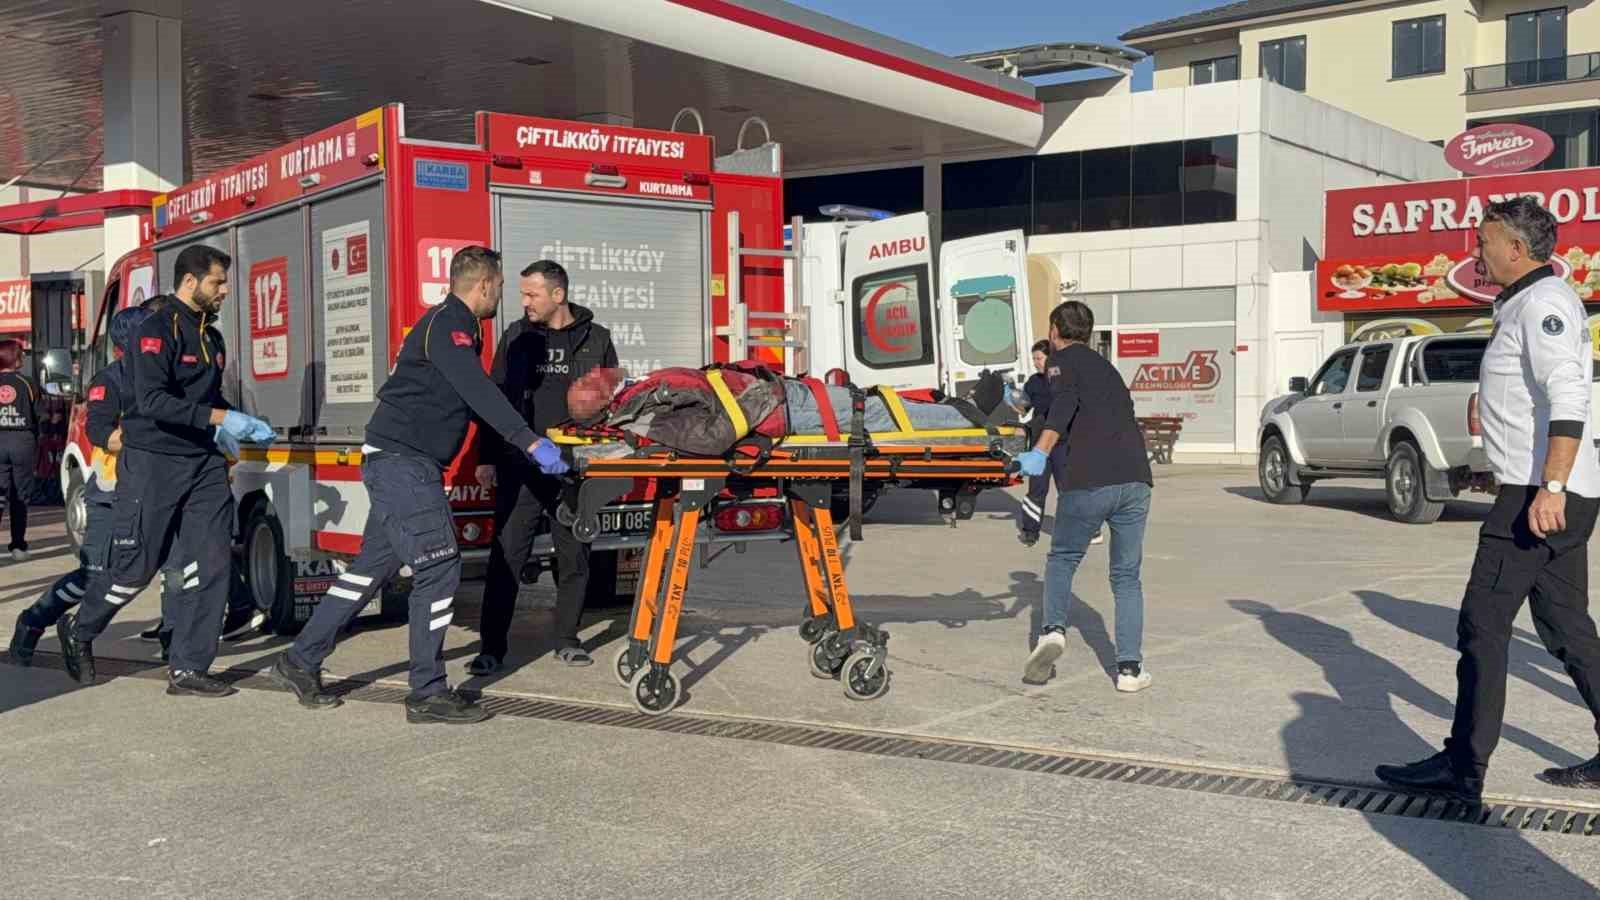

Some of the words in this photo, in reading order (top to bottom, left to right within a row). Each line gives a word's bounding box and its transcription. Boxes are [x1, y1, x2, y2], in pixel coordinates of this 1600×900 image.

[281, 136, 342, 179] KURTARMA
[639, 180, 693, 197] KURTARMA
[1352, 187, 1600, 236] SAFRAOL
[868, 236, 926, 260] AMBU
[255, 271, 283, 329] 112
[1136, 354, 1202, 381] ACTIVE
